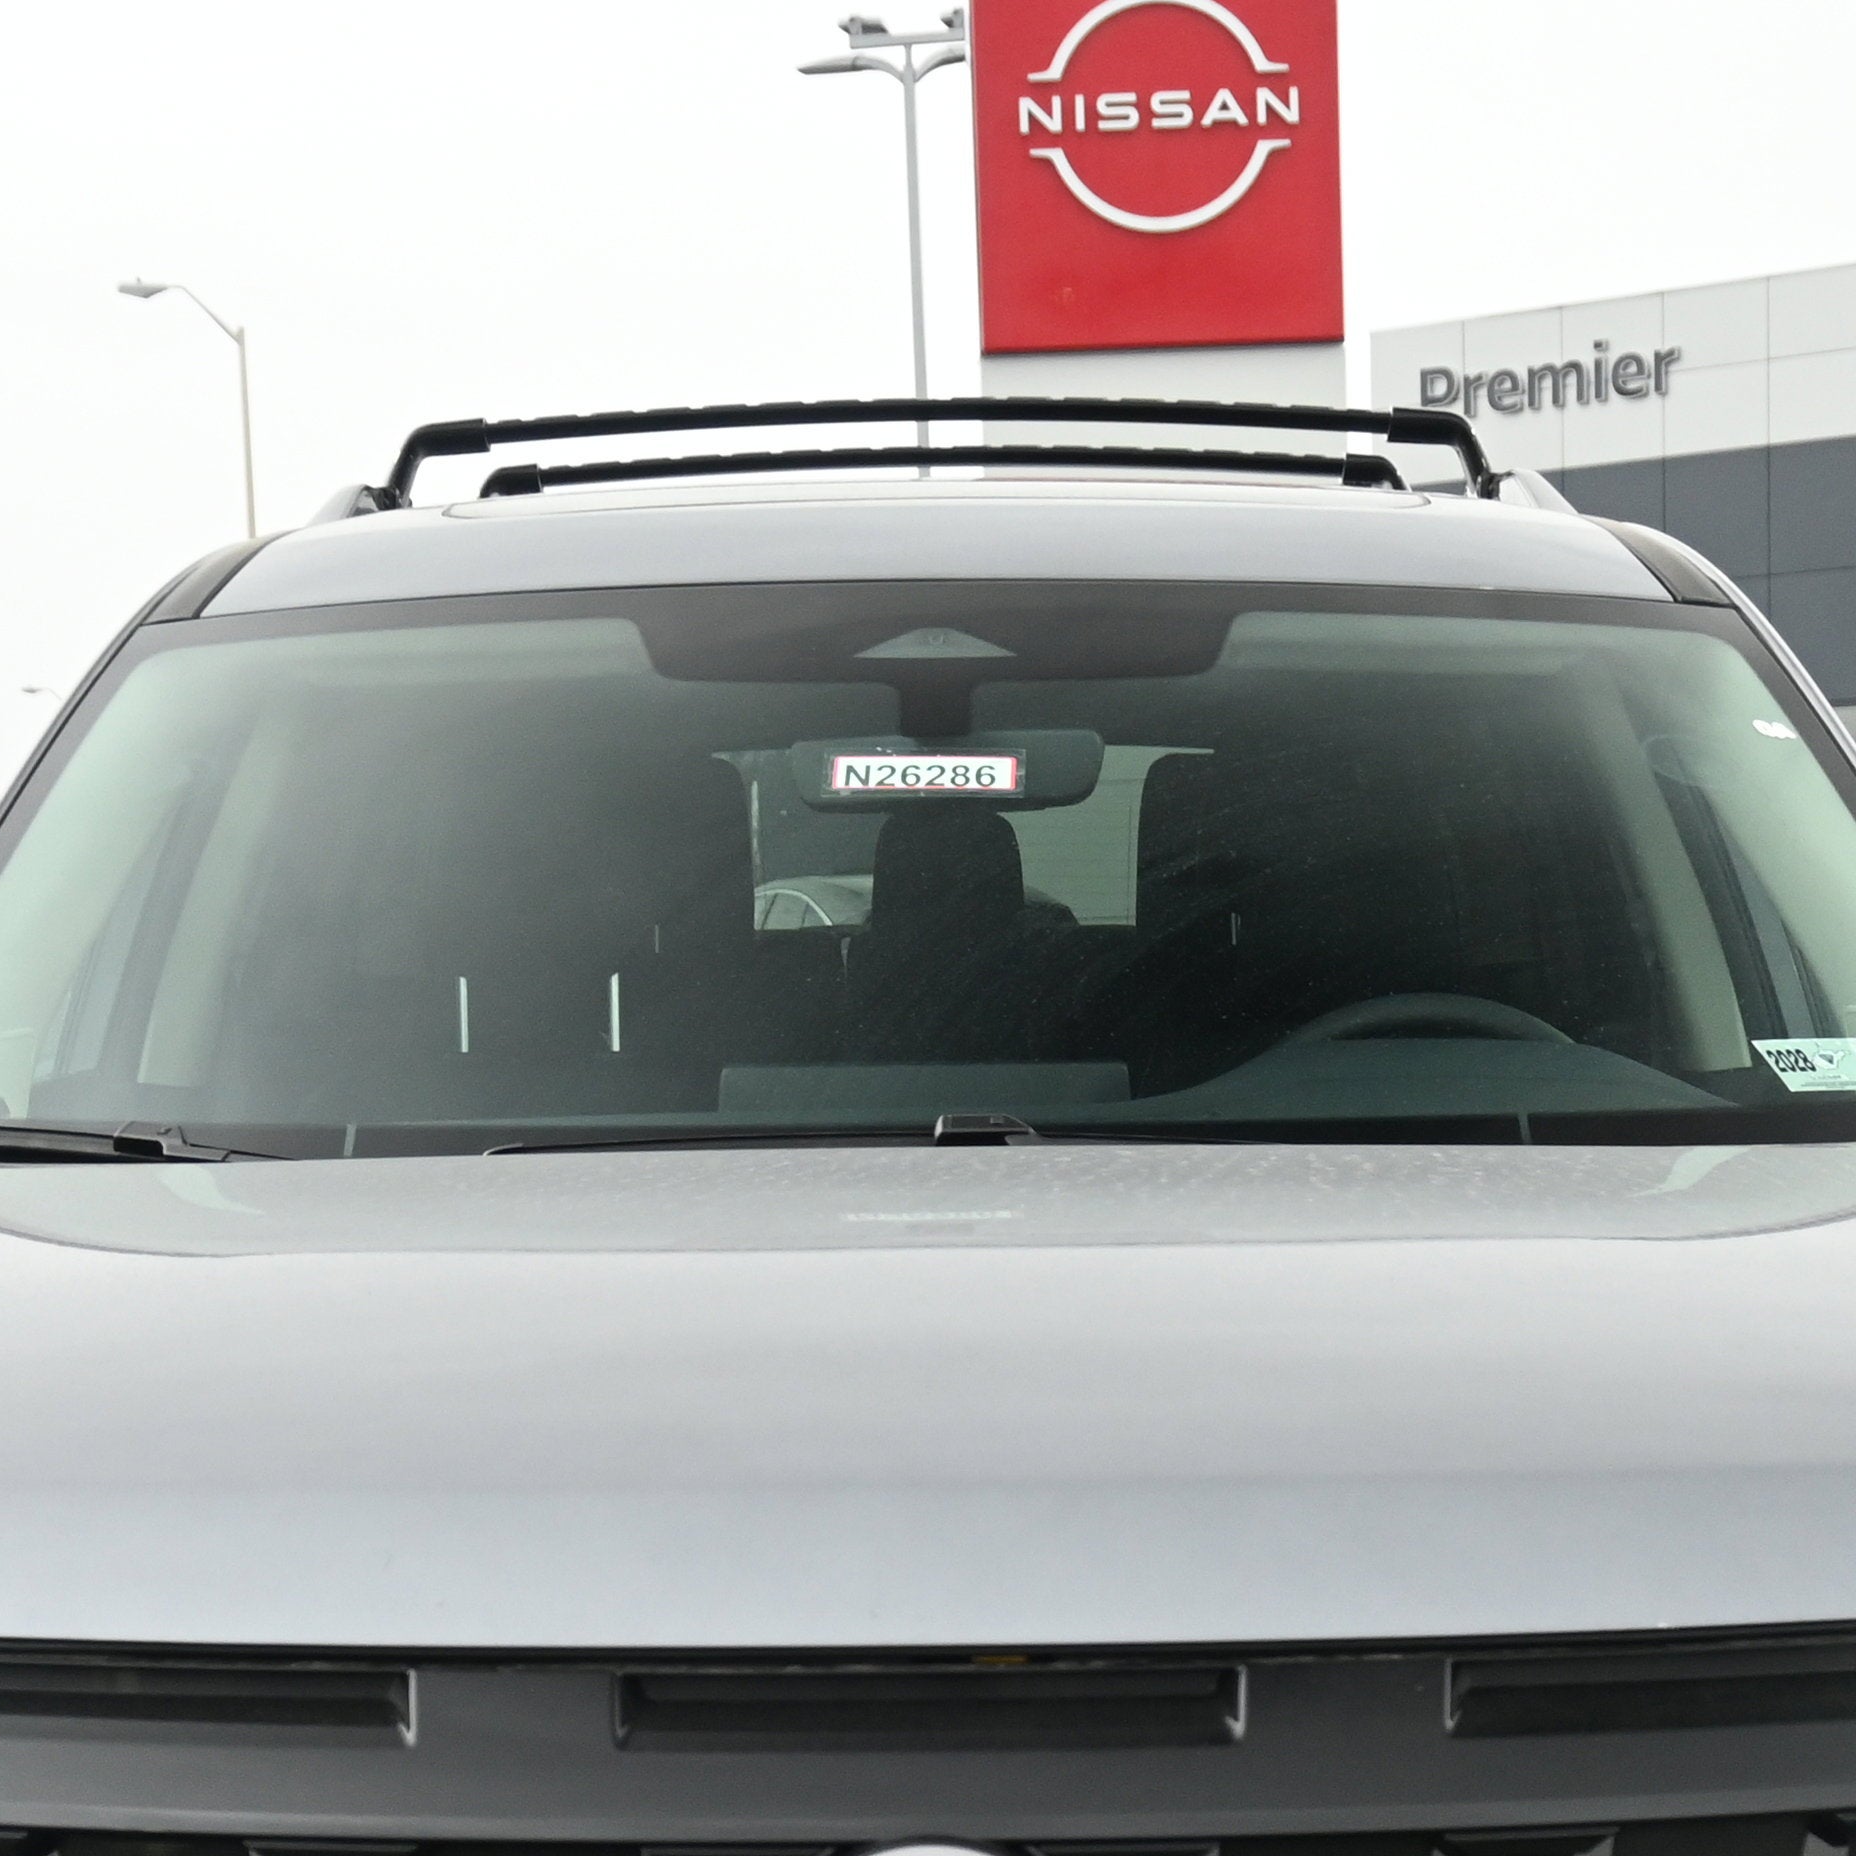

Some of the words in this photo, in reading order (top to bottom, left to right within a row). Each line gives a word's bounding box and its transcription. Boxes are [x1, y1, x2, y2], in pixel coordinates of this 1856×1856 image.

[1019, 86, 1300, 135] NISSAN
[1420, 340, 1680, 417] Premier
[845, 764, 996, 787] N26286
